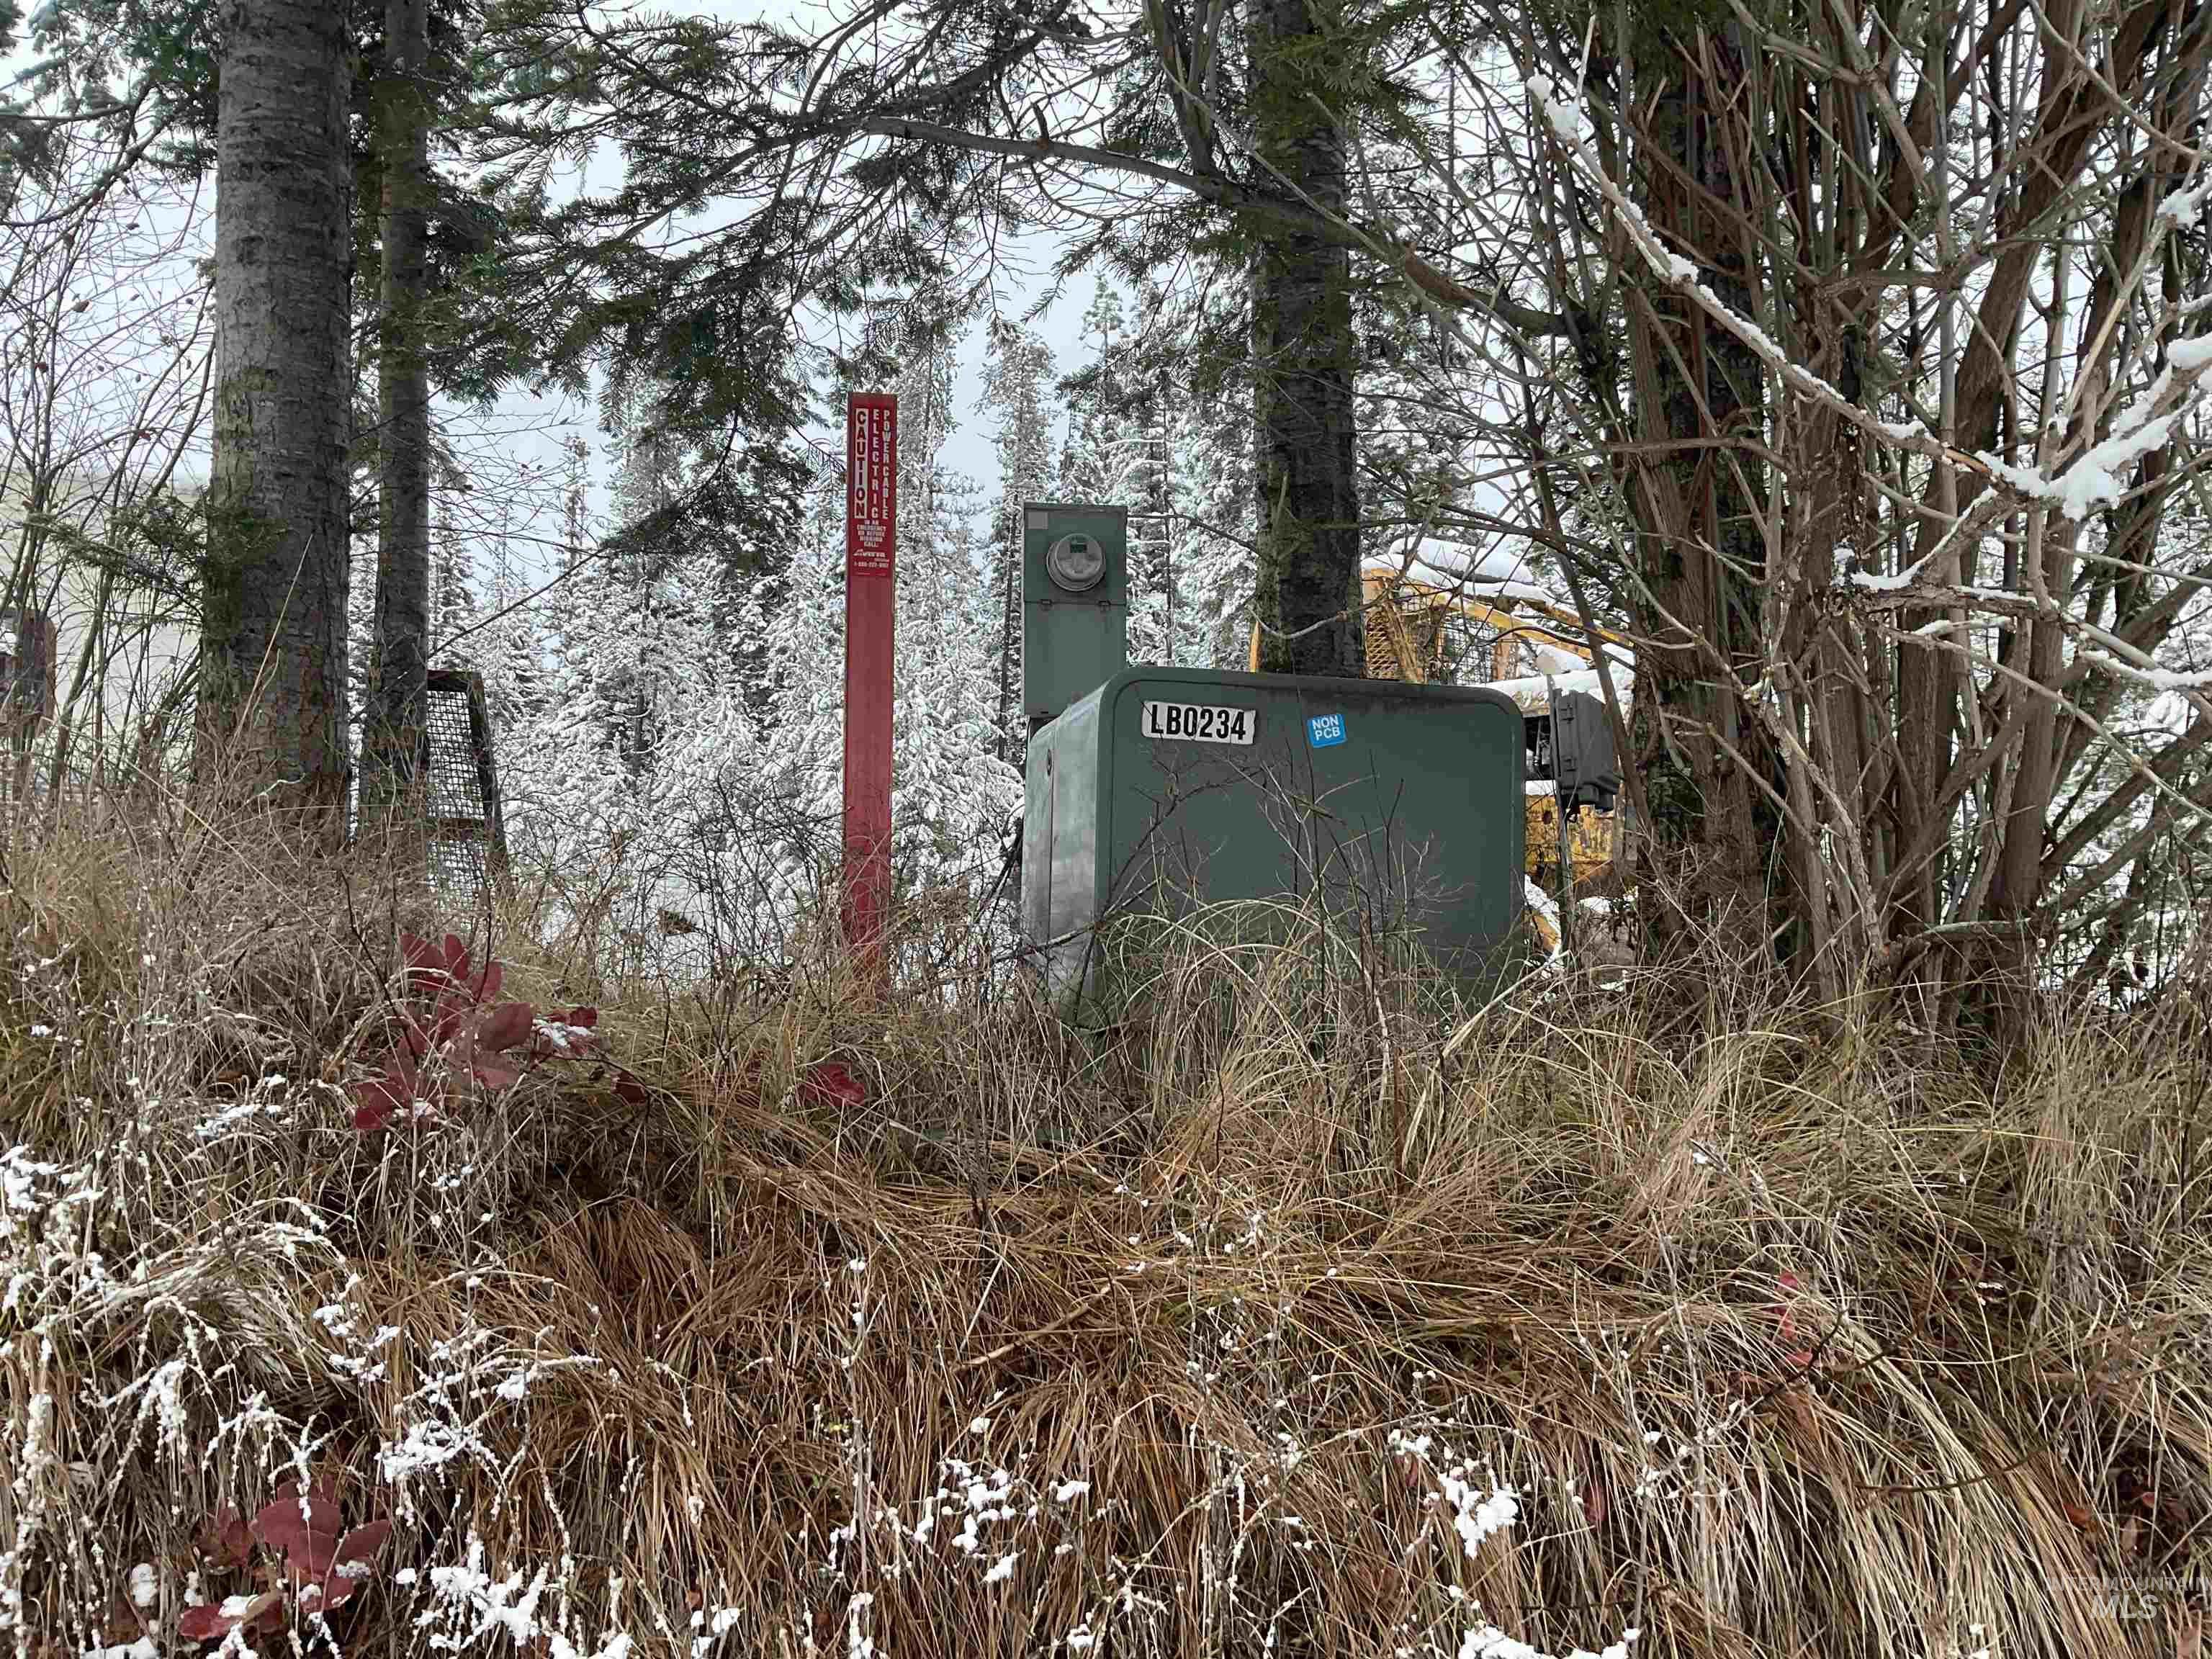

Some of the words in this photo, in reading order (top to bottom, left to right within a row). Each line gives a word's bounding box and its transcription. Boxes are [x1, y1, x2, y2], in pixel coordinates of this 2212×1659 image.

[855, 410, 867, 518] CAUTION
[871, 408, 880, 518] ELECTRIC
[882, 409, 891, 464] POWER
[1312, 715, 1339, 729] NON
[1314, 727, 1341, 741] PCB
